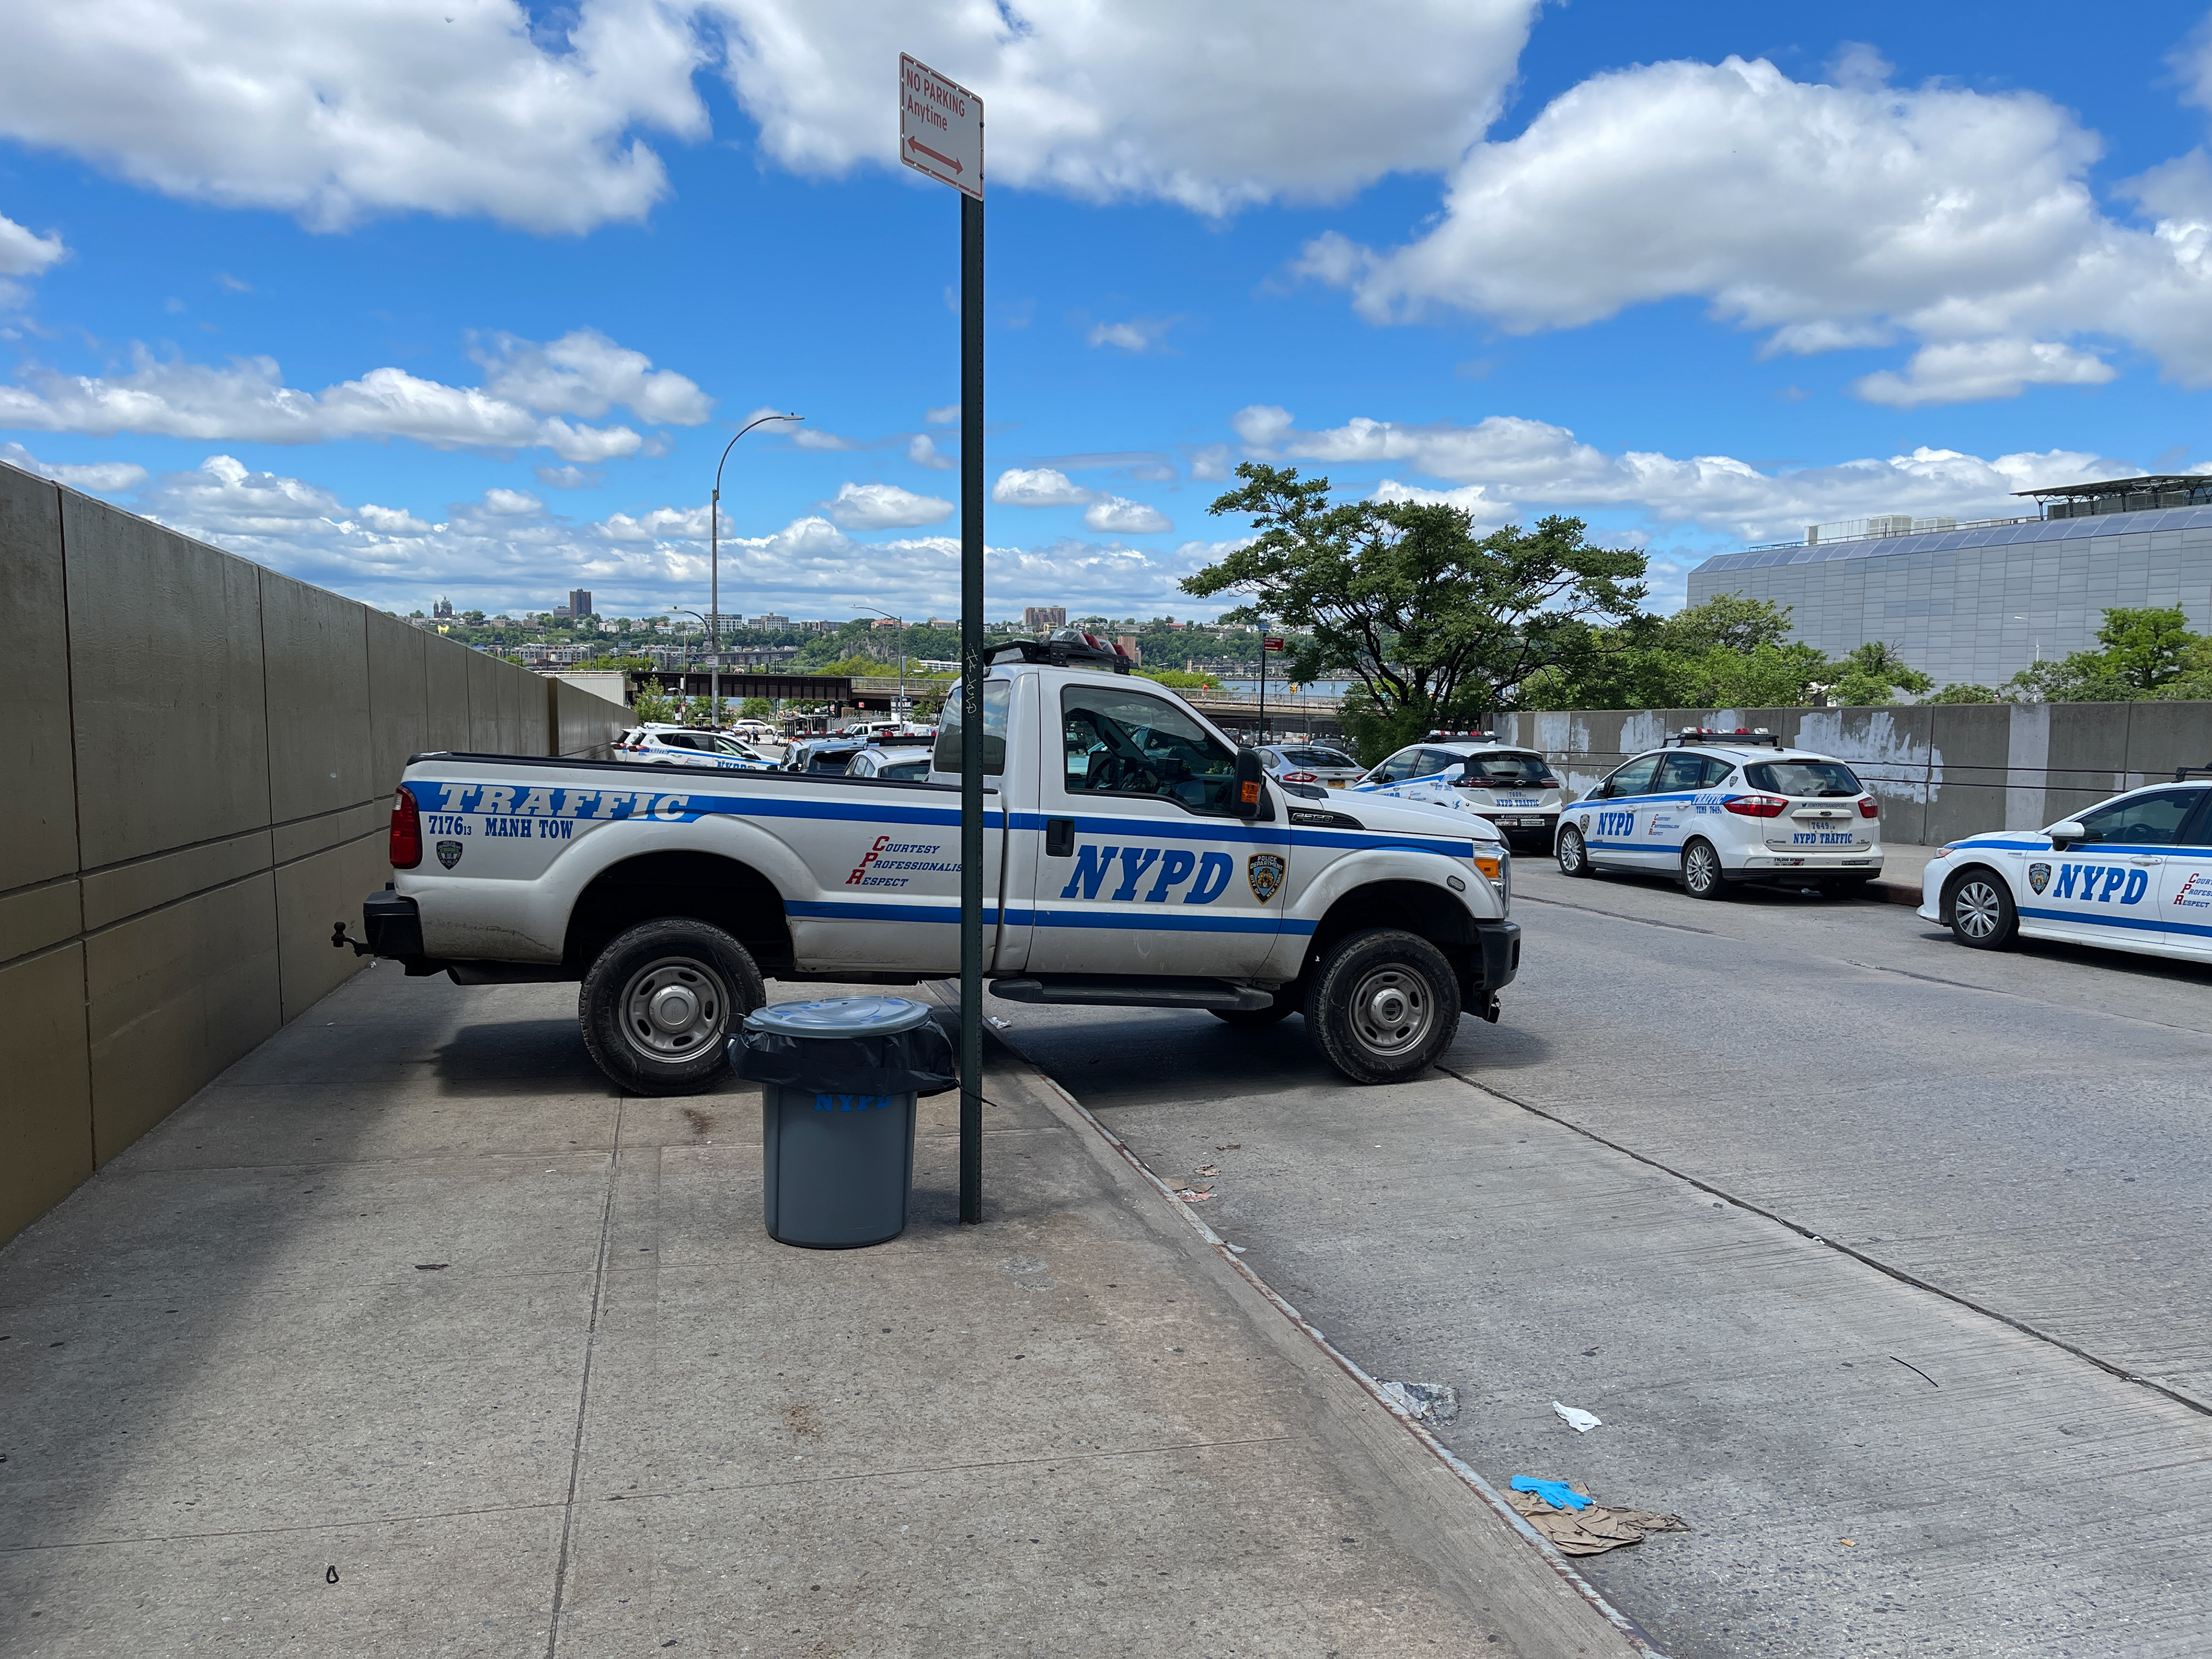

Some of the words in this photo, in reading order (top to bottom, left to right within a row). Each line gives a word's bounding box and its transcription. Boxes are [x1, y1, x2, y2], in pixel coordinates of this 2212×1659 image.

[907, 68, 921, 92] NO
[924, 78, 965, 118] PARKING
[907, 94, 948, 131] Anytime
[439, 783, 690, 821] TRAFFIC
[1692, 794, 1726, 805] TRAFFIC
[485, 817, 532, 838] MANH
[539, 819, 574, 839] TOW
[1597, 812, 1634, 836] NYPD
[872, 836, 941, 854] COURTESY
[1793, 833, 1816, 844] NYPD
[1819, 833, 1853, 844] TRAFFIC
[858, 852, 961, 872] PROFESSIONALIS
[1250, 861, 1283, 871] DEPARTMENT
[845, 869, 909, 887] RESPECT
[1060, 844, 1234, 904] NYPD
[2052, 863, 2149, 905] NYPD
[1266, 888, 1276, 898] NEW
[1274, 873, 1283, 887] YORK
[2173, 894, 2210, 908] RESPECT
